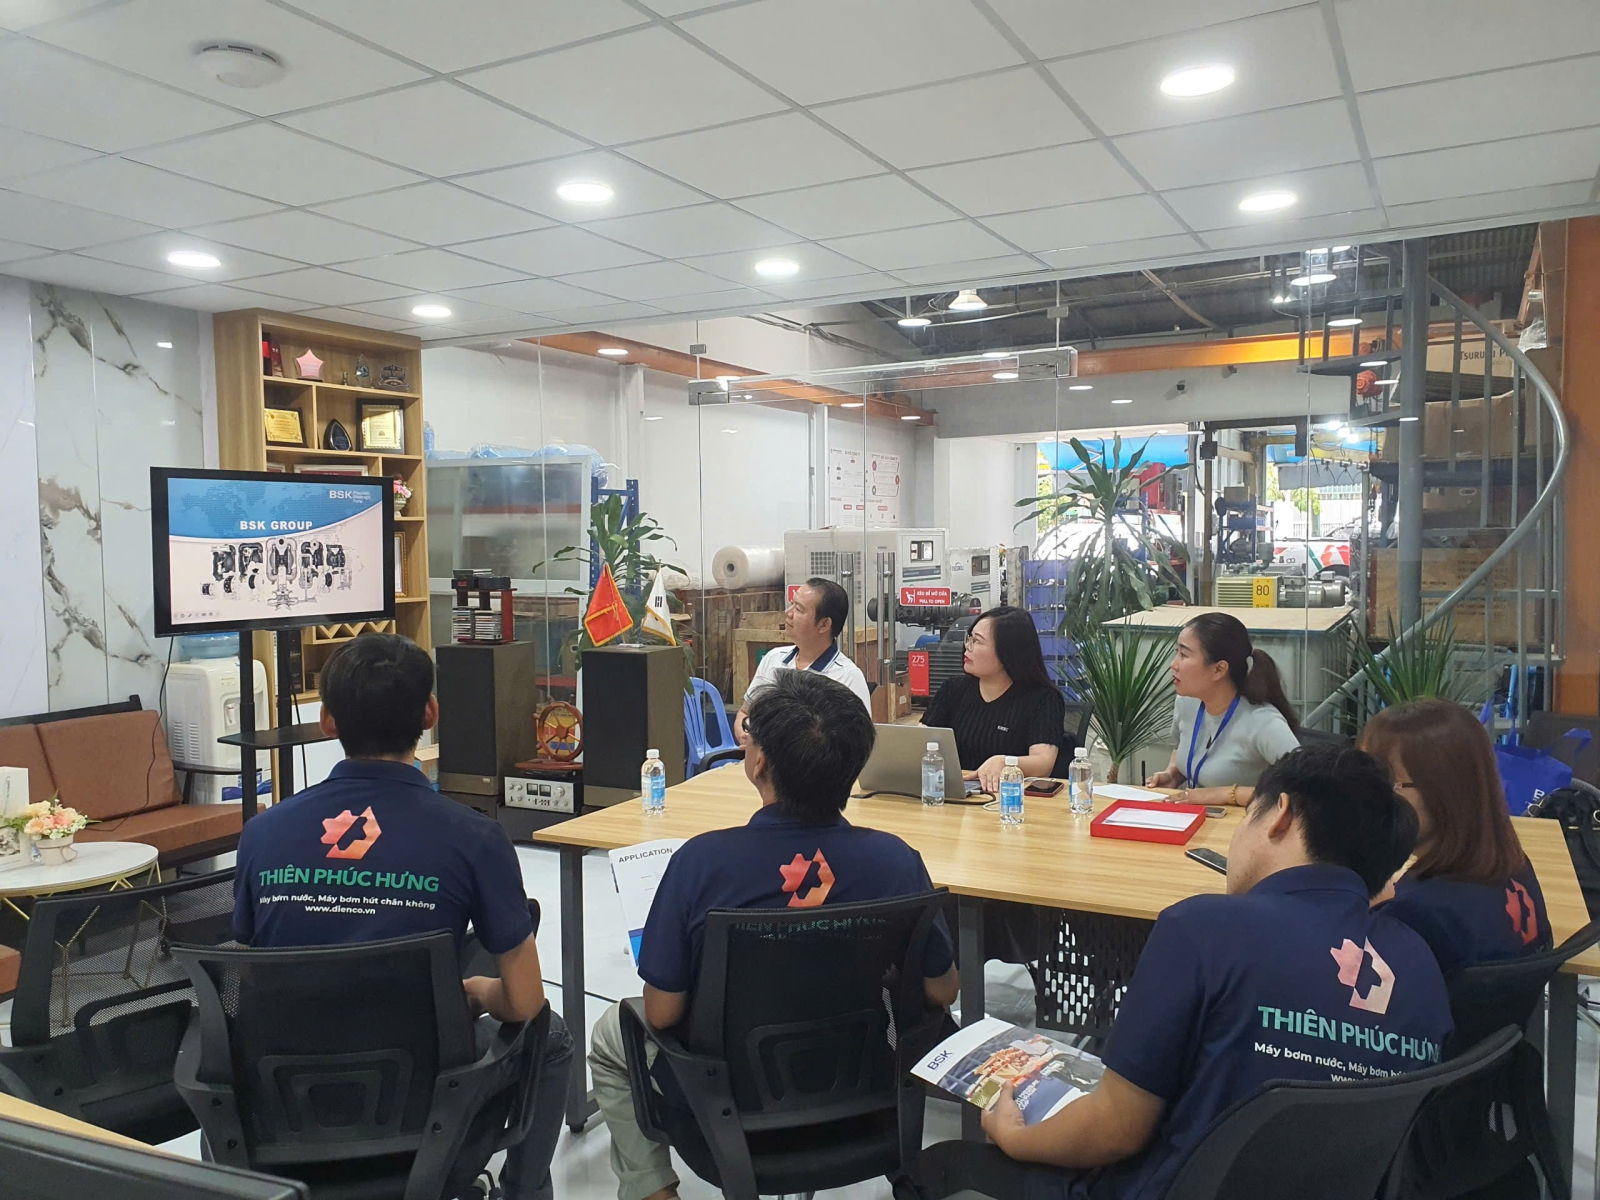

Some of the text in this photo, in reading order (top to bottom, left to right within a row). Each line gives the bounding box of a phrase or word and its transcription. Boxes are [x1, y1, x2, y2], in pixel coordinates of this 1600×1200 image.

[329, 490, 352, 499] BSK
[240, 520, 313, 530] BSK GROUP
[1256, 584, 1270, 596] 80
[912, 655, 925, 664] 275
[618, 847, 673, 864] APPLICATION
[258, 864, 440, 892] THIÊN PHÚC HƯNG
[305, 905, 376, 915] www.dienco.vn
[318, 894, 338, 904] Máy
[339, 895, 361, 904] bơm
[363, 896, 379, 905] hút
[380, 897, 403, 906] chân
[405, 900, 436, 910] không
[1258, 1005, 1440, 1063] THIÊN PHÚC HƯN
[927, 1049, 953, 1071] BSK
[1254, 1041, 1282, 1058] Máy
[1284, 1048, 1312, 1063] bơm
[1315, 1055, 1346, 1071] nước,
[1348, 1061, 1368, 1076] Máy
[1369, 1065, 1388, 1078] bơm
